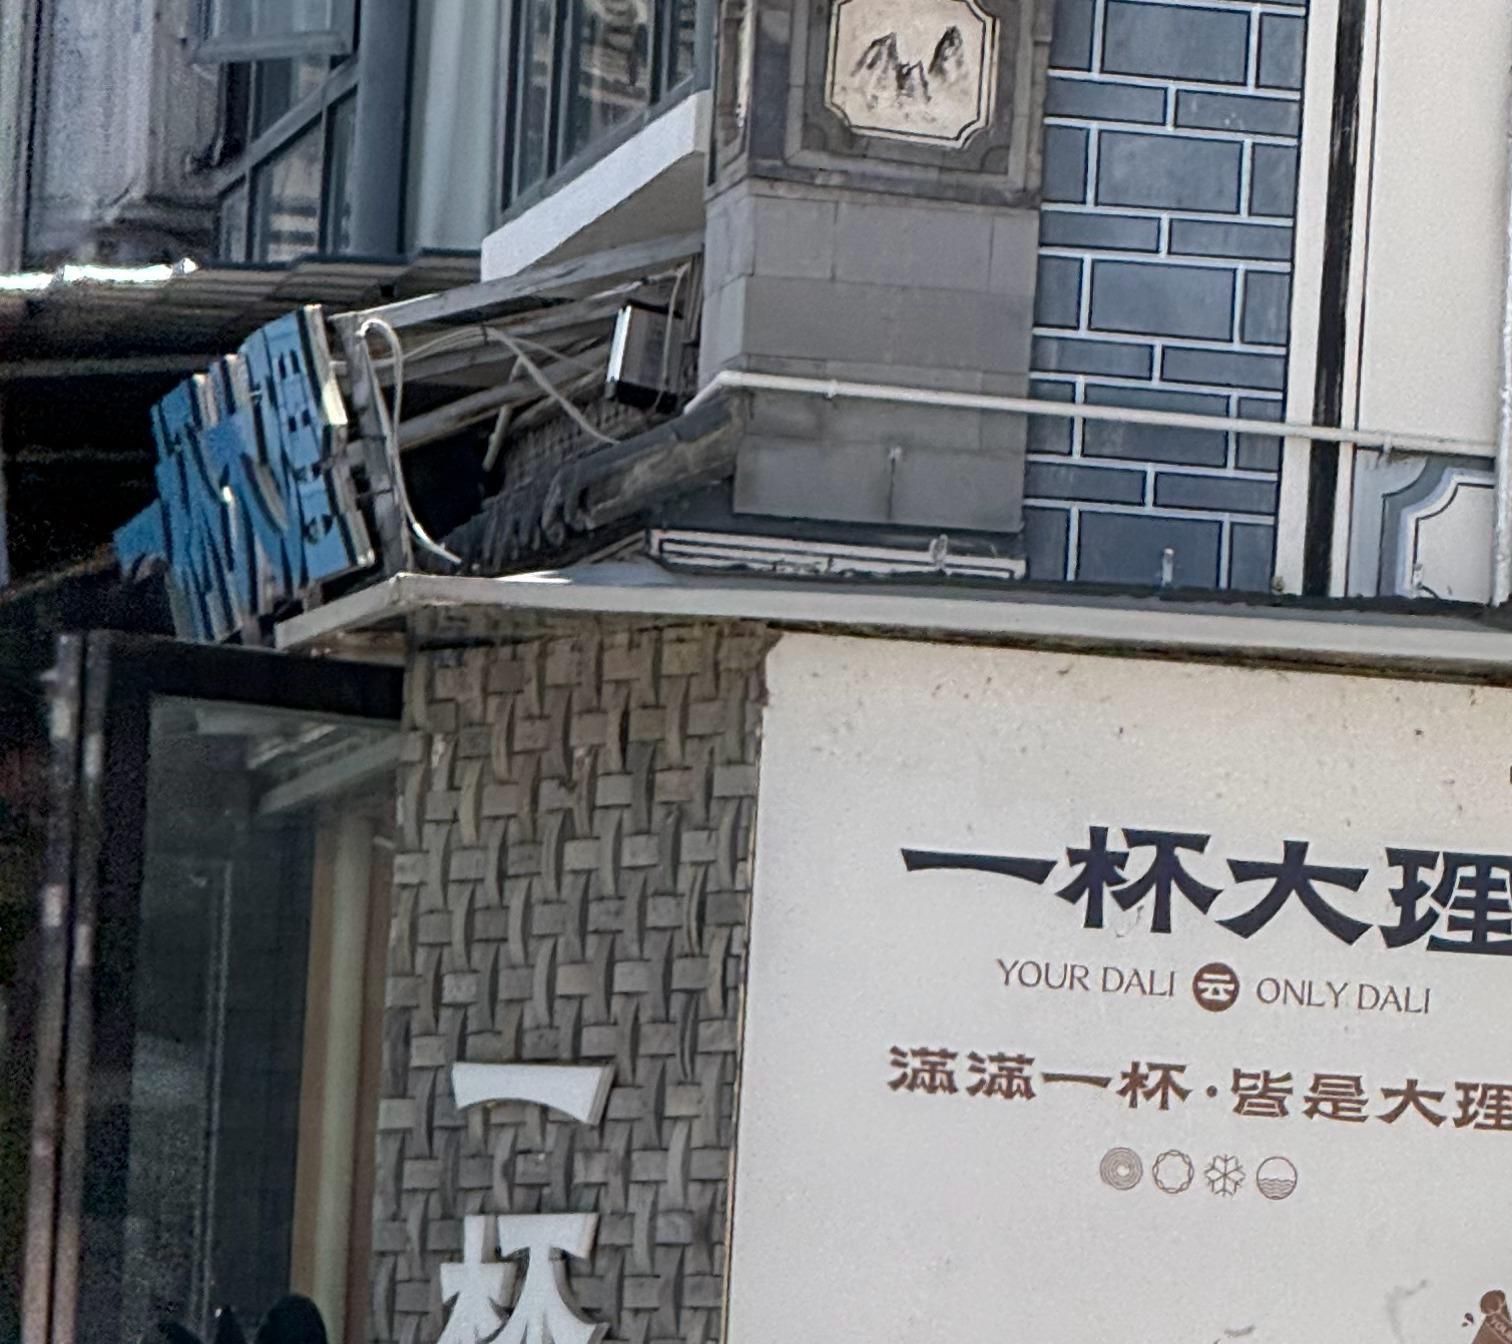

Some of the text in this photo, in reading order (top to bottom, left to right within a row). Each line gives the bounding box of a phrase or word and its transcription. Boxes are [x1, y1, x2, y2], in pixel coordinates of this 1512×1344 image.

[997, 960, 1090, 991] YOUR
[1101, 966, 1175, 997] DALI
[1255, 977, 1348, 1009] ONLY
[1357, 983, 1431, 1014] DALI
